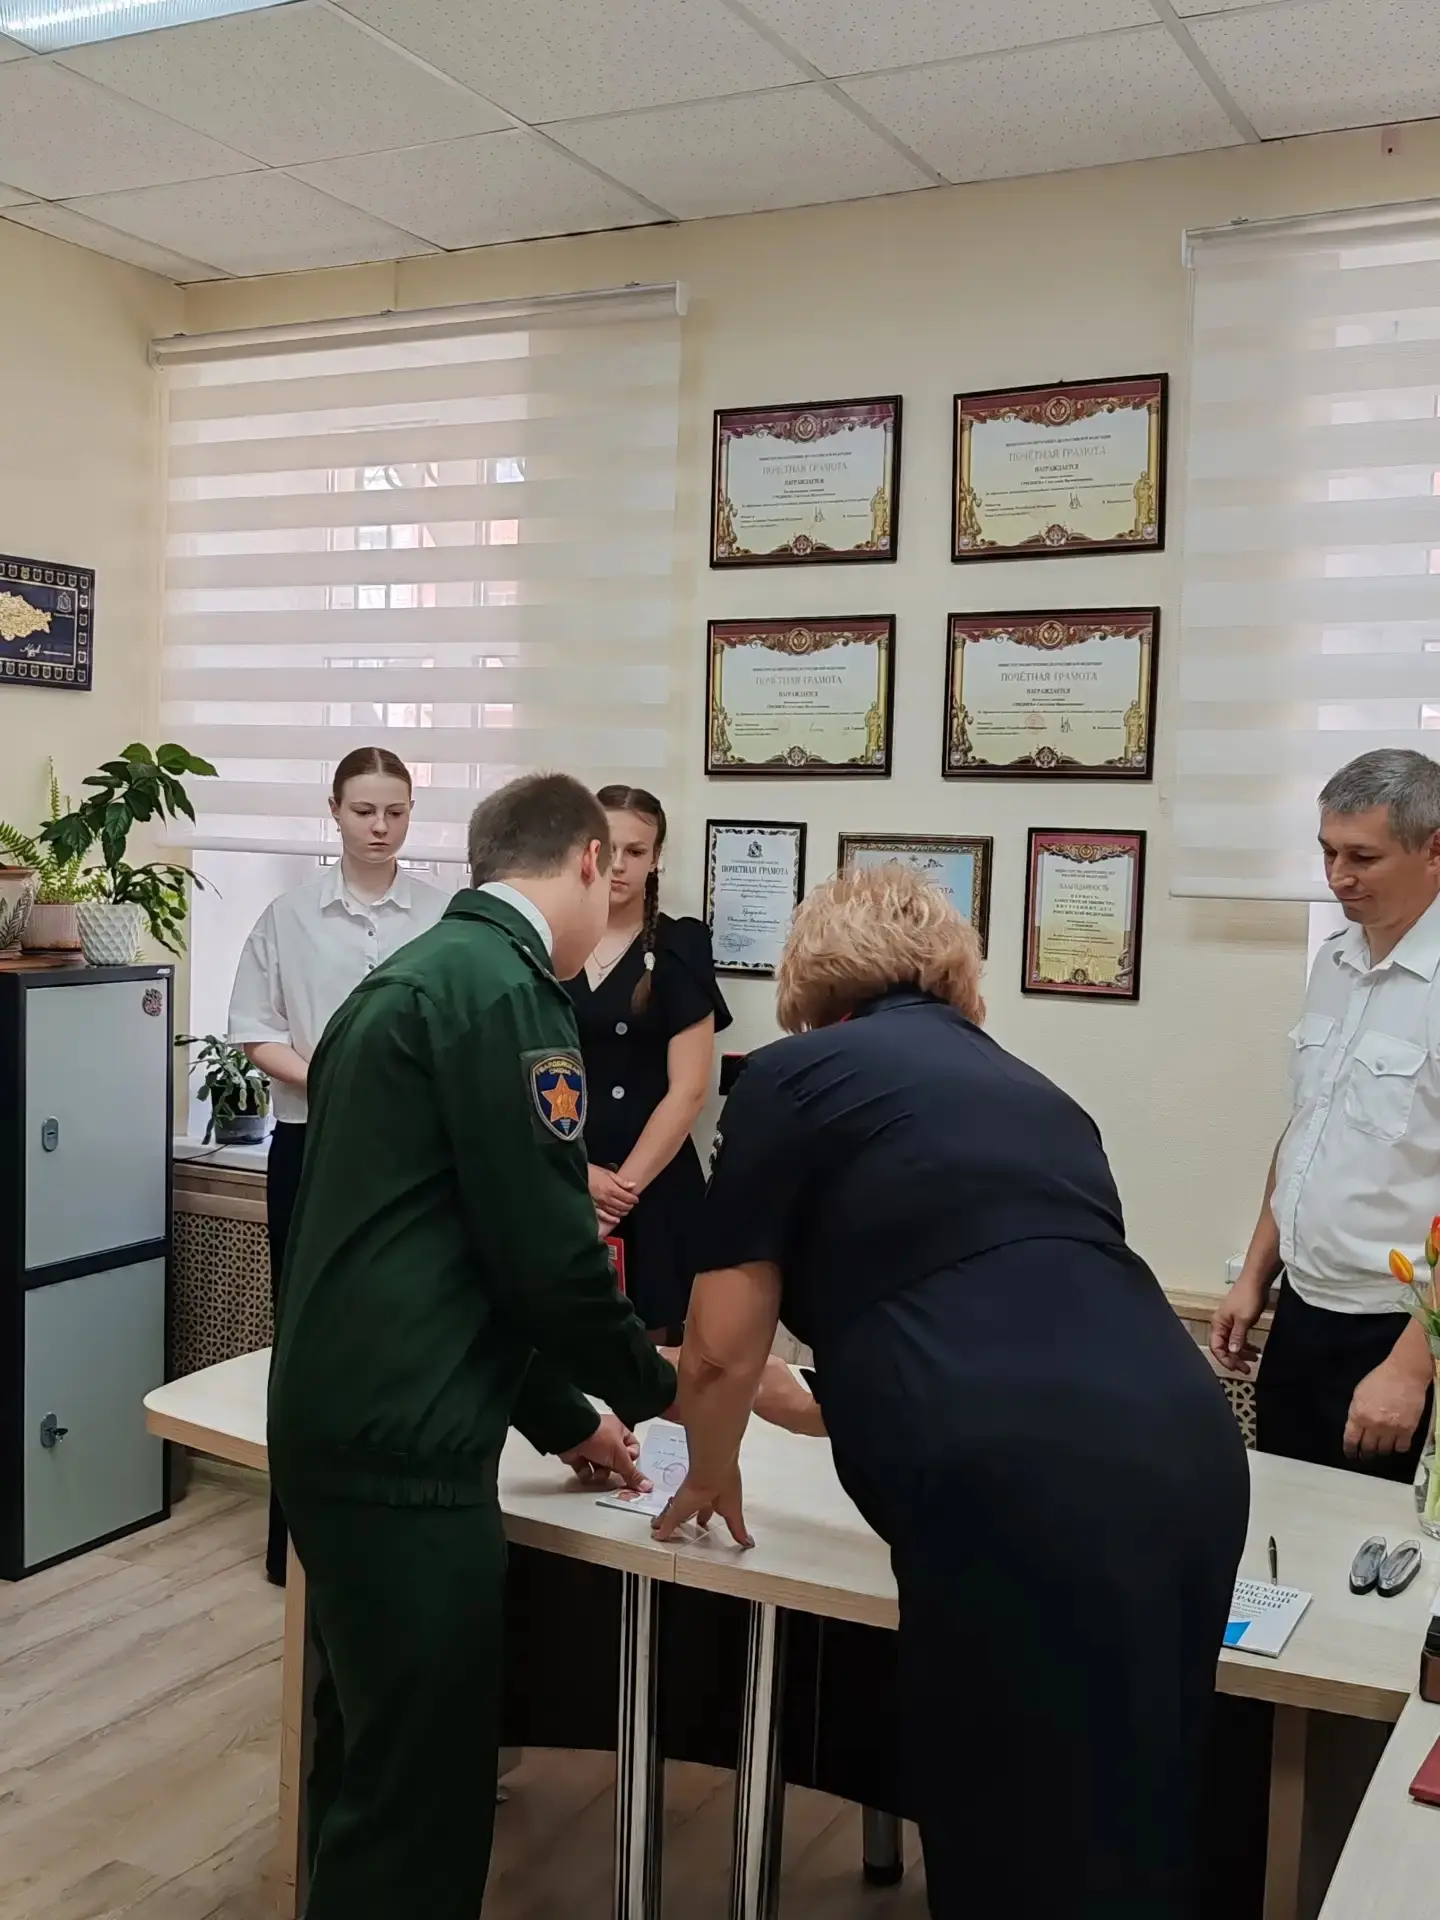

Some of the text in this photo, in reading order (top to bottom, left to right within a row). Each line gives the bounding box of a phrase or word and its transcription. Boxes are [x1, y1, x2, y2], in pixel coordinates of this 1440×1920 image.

[1054, 671, 1098, 682] ГРАМОТА
[1235, 1588, 1291, 1604] ИЙСКОЙ
[1236, 1581, 1299, 1599] ТИТУЦИЯ
